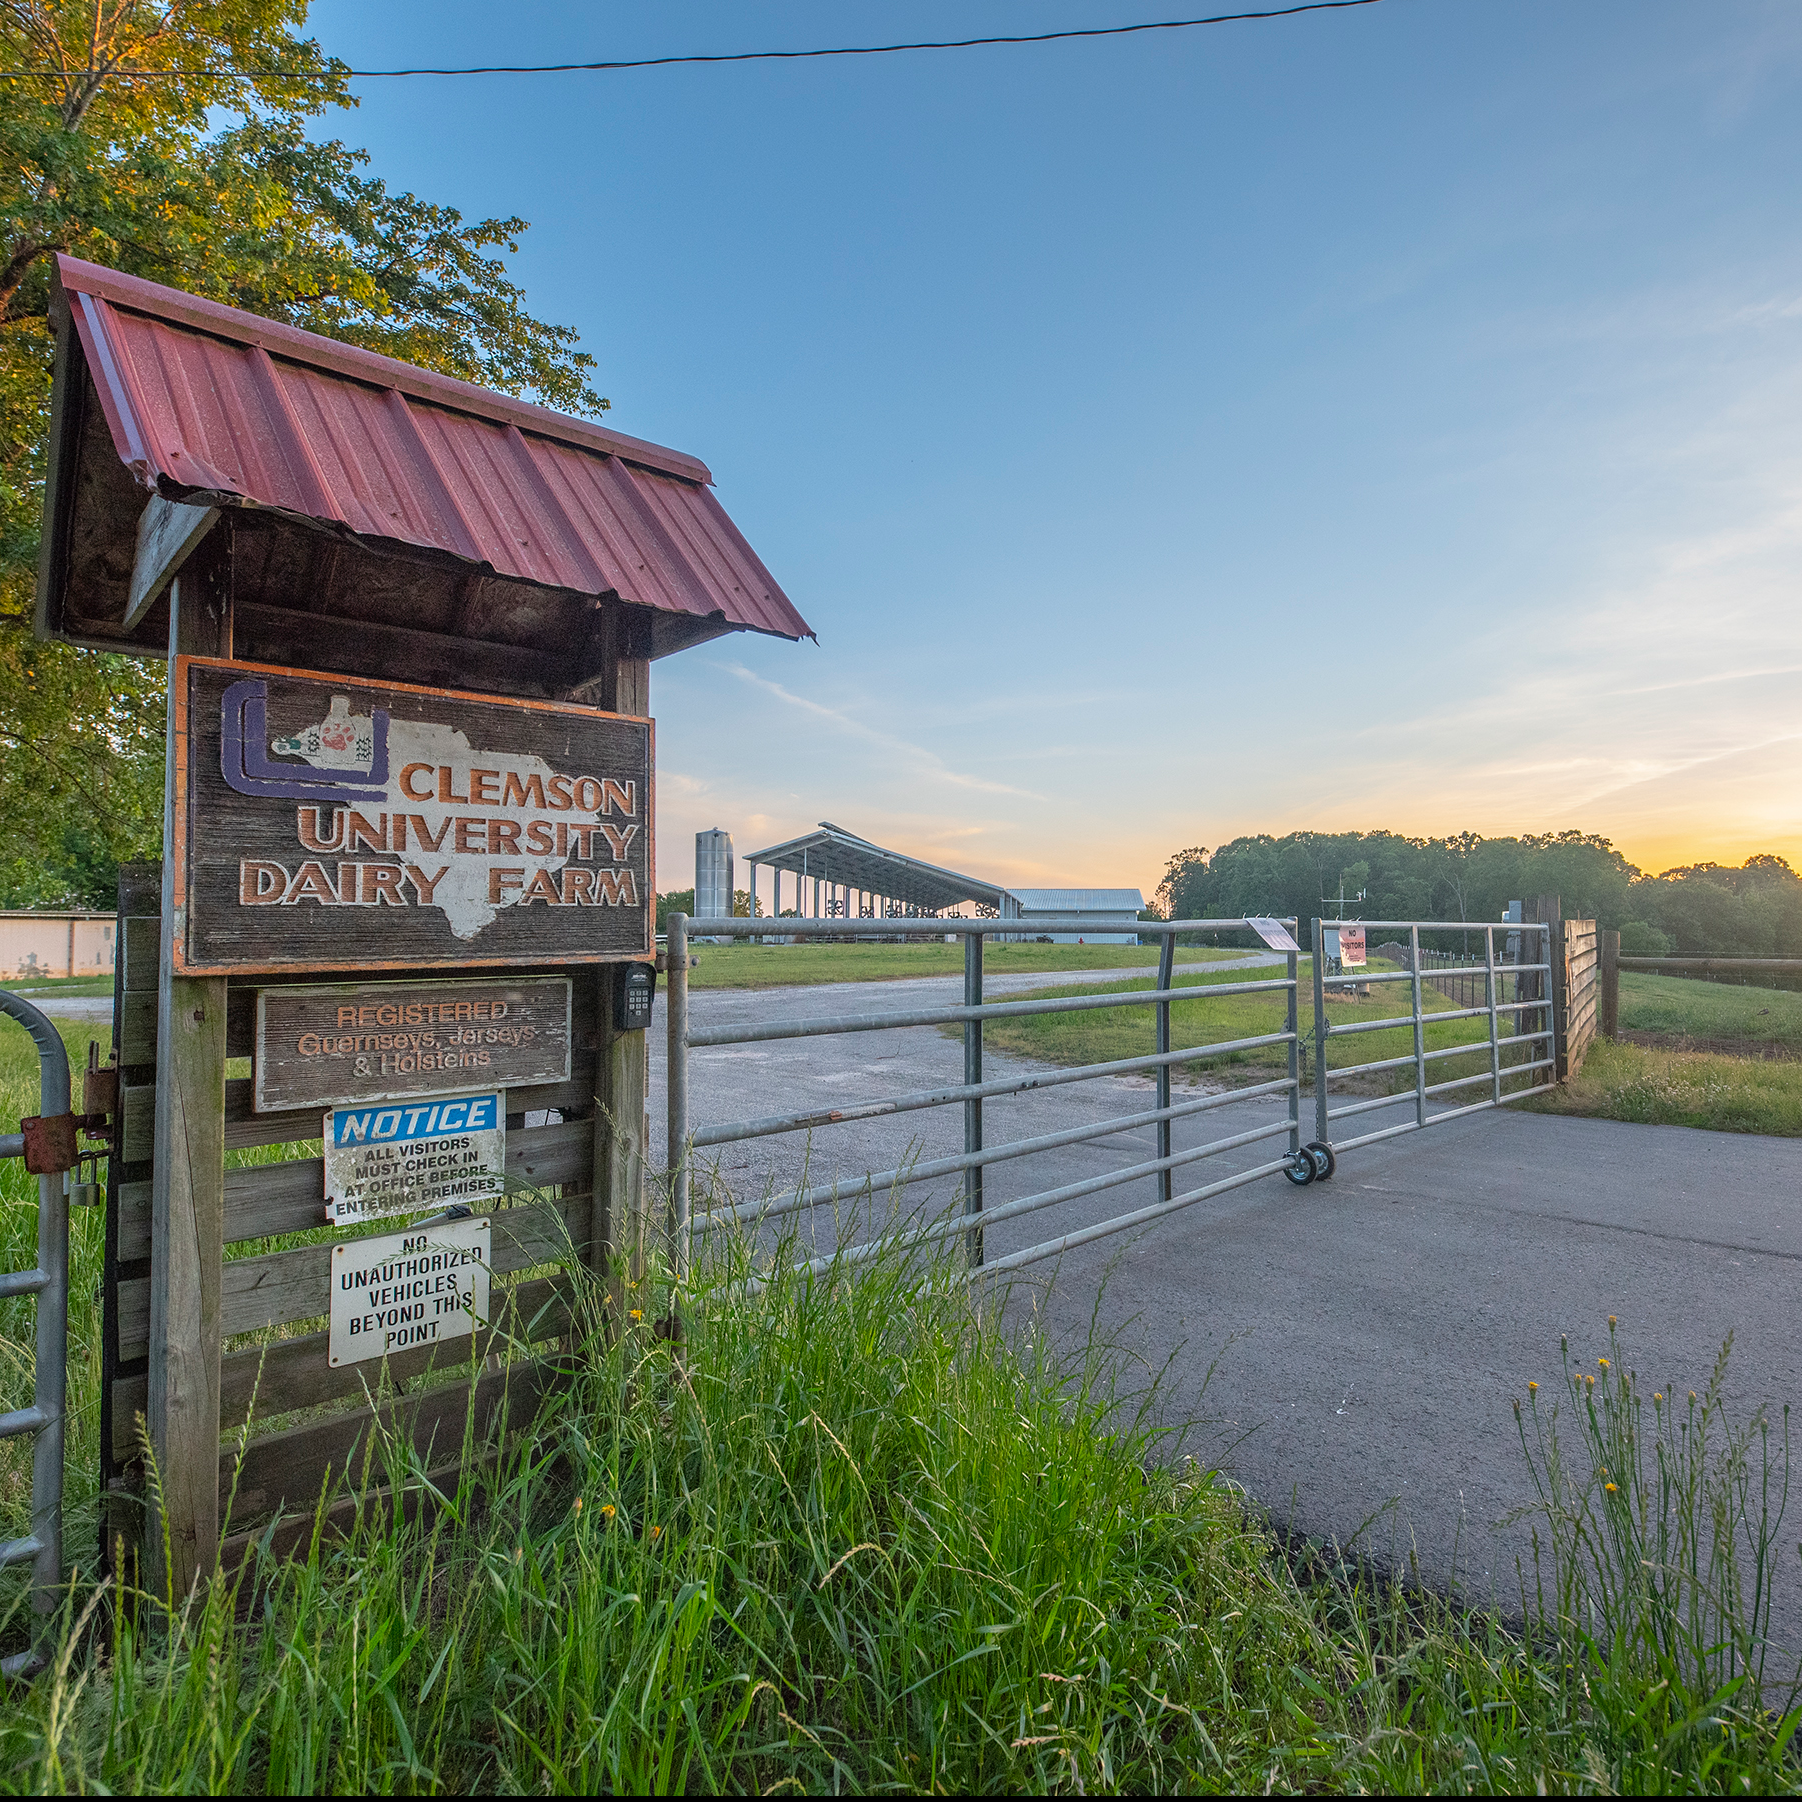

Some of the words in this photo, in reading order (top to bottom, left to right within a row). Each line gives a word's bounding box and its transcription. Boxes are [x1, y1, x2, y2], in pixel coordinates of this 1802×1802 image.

[399, 762, 636, 817] CLEMSON
[297, 805, 638, 861] UNIVERSITY
[239, 859, 450, 907] DAIRY
[488, 866, 638, 907] FARM
[1341, 941, 1365, 950] VISITORS
[1348, 929, 1357, 938] NO
[336, 1000, 508, 1028] REGISTERED
[298, 1030, 441, 1056] Guernseys,
[448, 1024, 537, 1047] Jerseys
[352, 1056, 373, 1077] &
[380, 1049, 491, 1075] Holsteins
[340, 1099, 492, 1144] NOTICE
[355, 1162, 401, 1180] MUST
[404, 1153, 458, 1173] CHECK
[463, 1150, 479, 1163] IN
[363, 1149, 395, 1163] ALL
[399, 1137, 471, 1158] VISITORS
[336, 1192, 418, 1216] ENTERING
[421, 1177, 497, 1202] PREMISES
[344, 1183, 366, 1199] AT
[369, 1174, 425, 1194] OFFICE
[428, 1164, 489, 1184] BEFORE
[402, 1235, 428, 1252] NO
[341, 1246, 482, 1291] UNAUTHORIZED
[369, 1273, 458, 1308] VEHICLES
[350, 1302, 425, 1336] BEYOND
[433, 1291, 473, 1316] THIS
[386, 1320, 440, 1350] POINT
